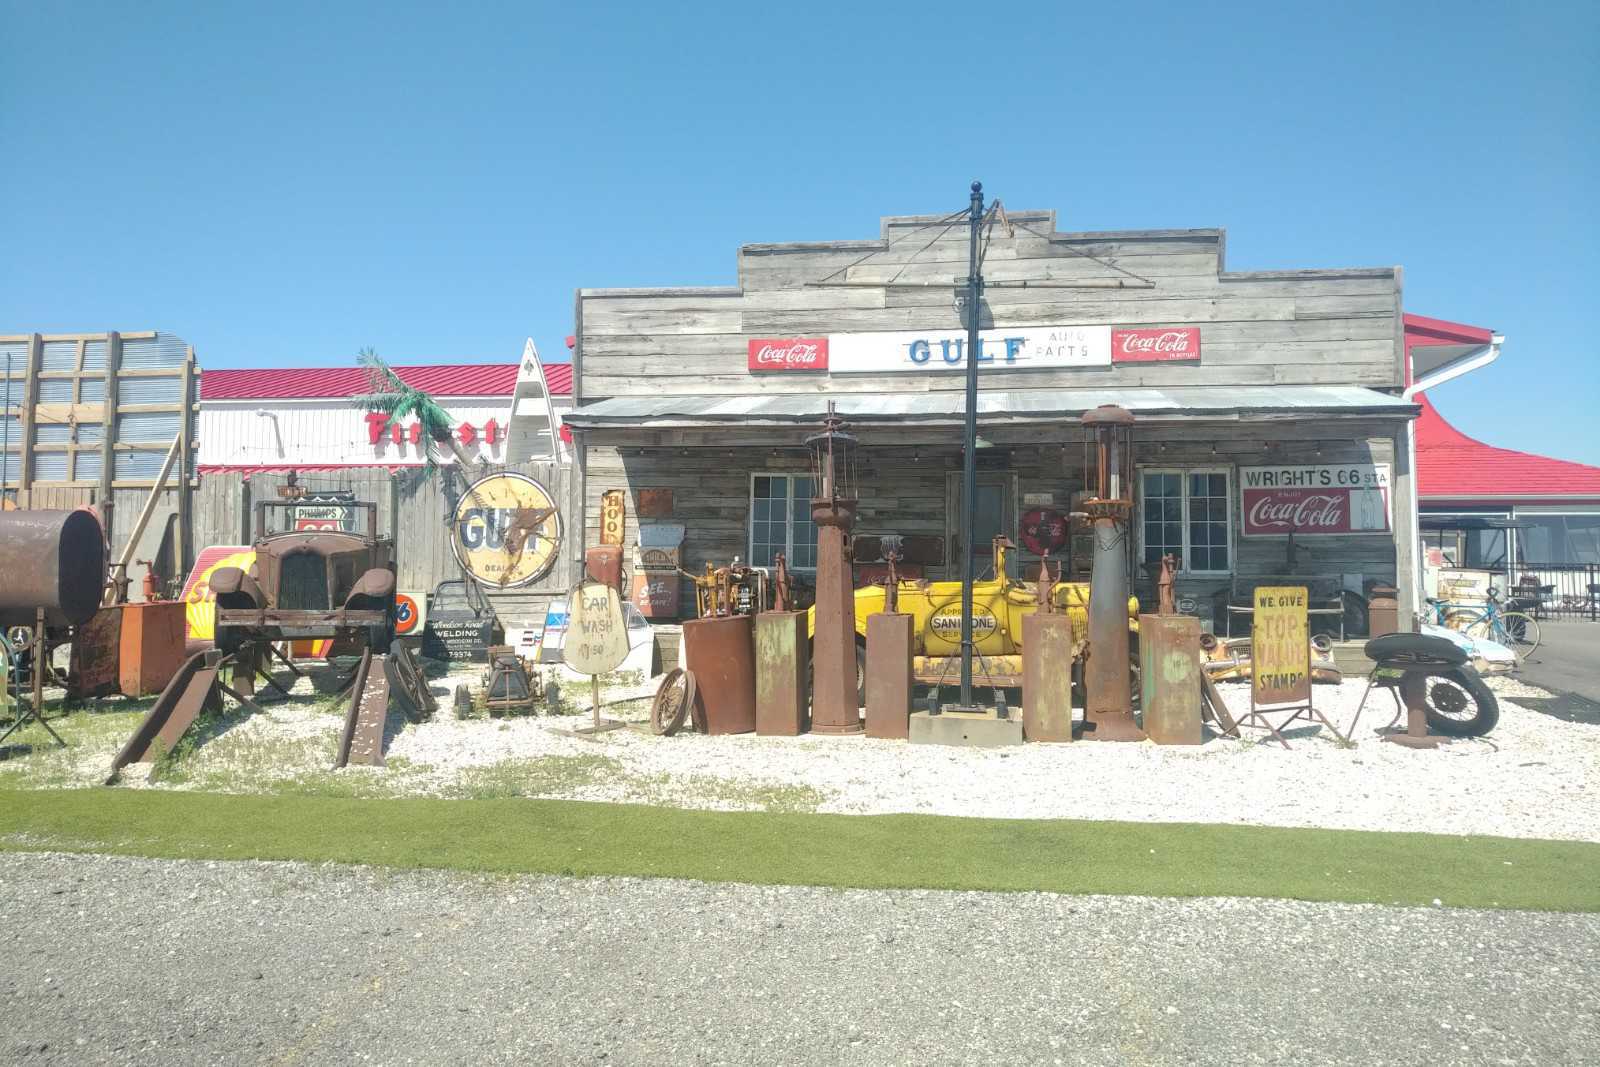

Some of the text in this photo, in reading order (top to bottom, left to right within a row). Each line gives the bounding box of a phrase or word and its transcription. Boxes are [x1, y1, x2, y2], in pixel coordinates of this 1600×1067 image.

[909, 338, 1026, 366] GULF
[1250, 495, 1344, 528] Coca-Cola
[582, 597, 608, 611] CAR
[1278, 595, 1303, 608] GIVE
[933, 617, 994, 629] SANIONE
